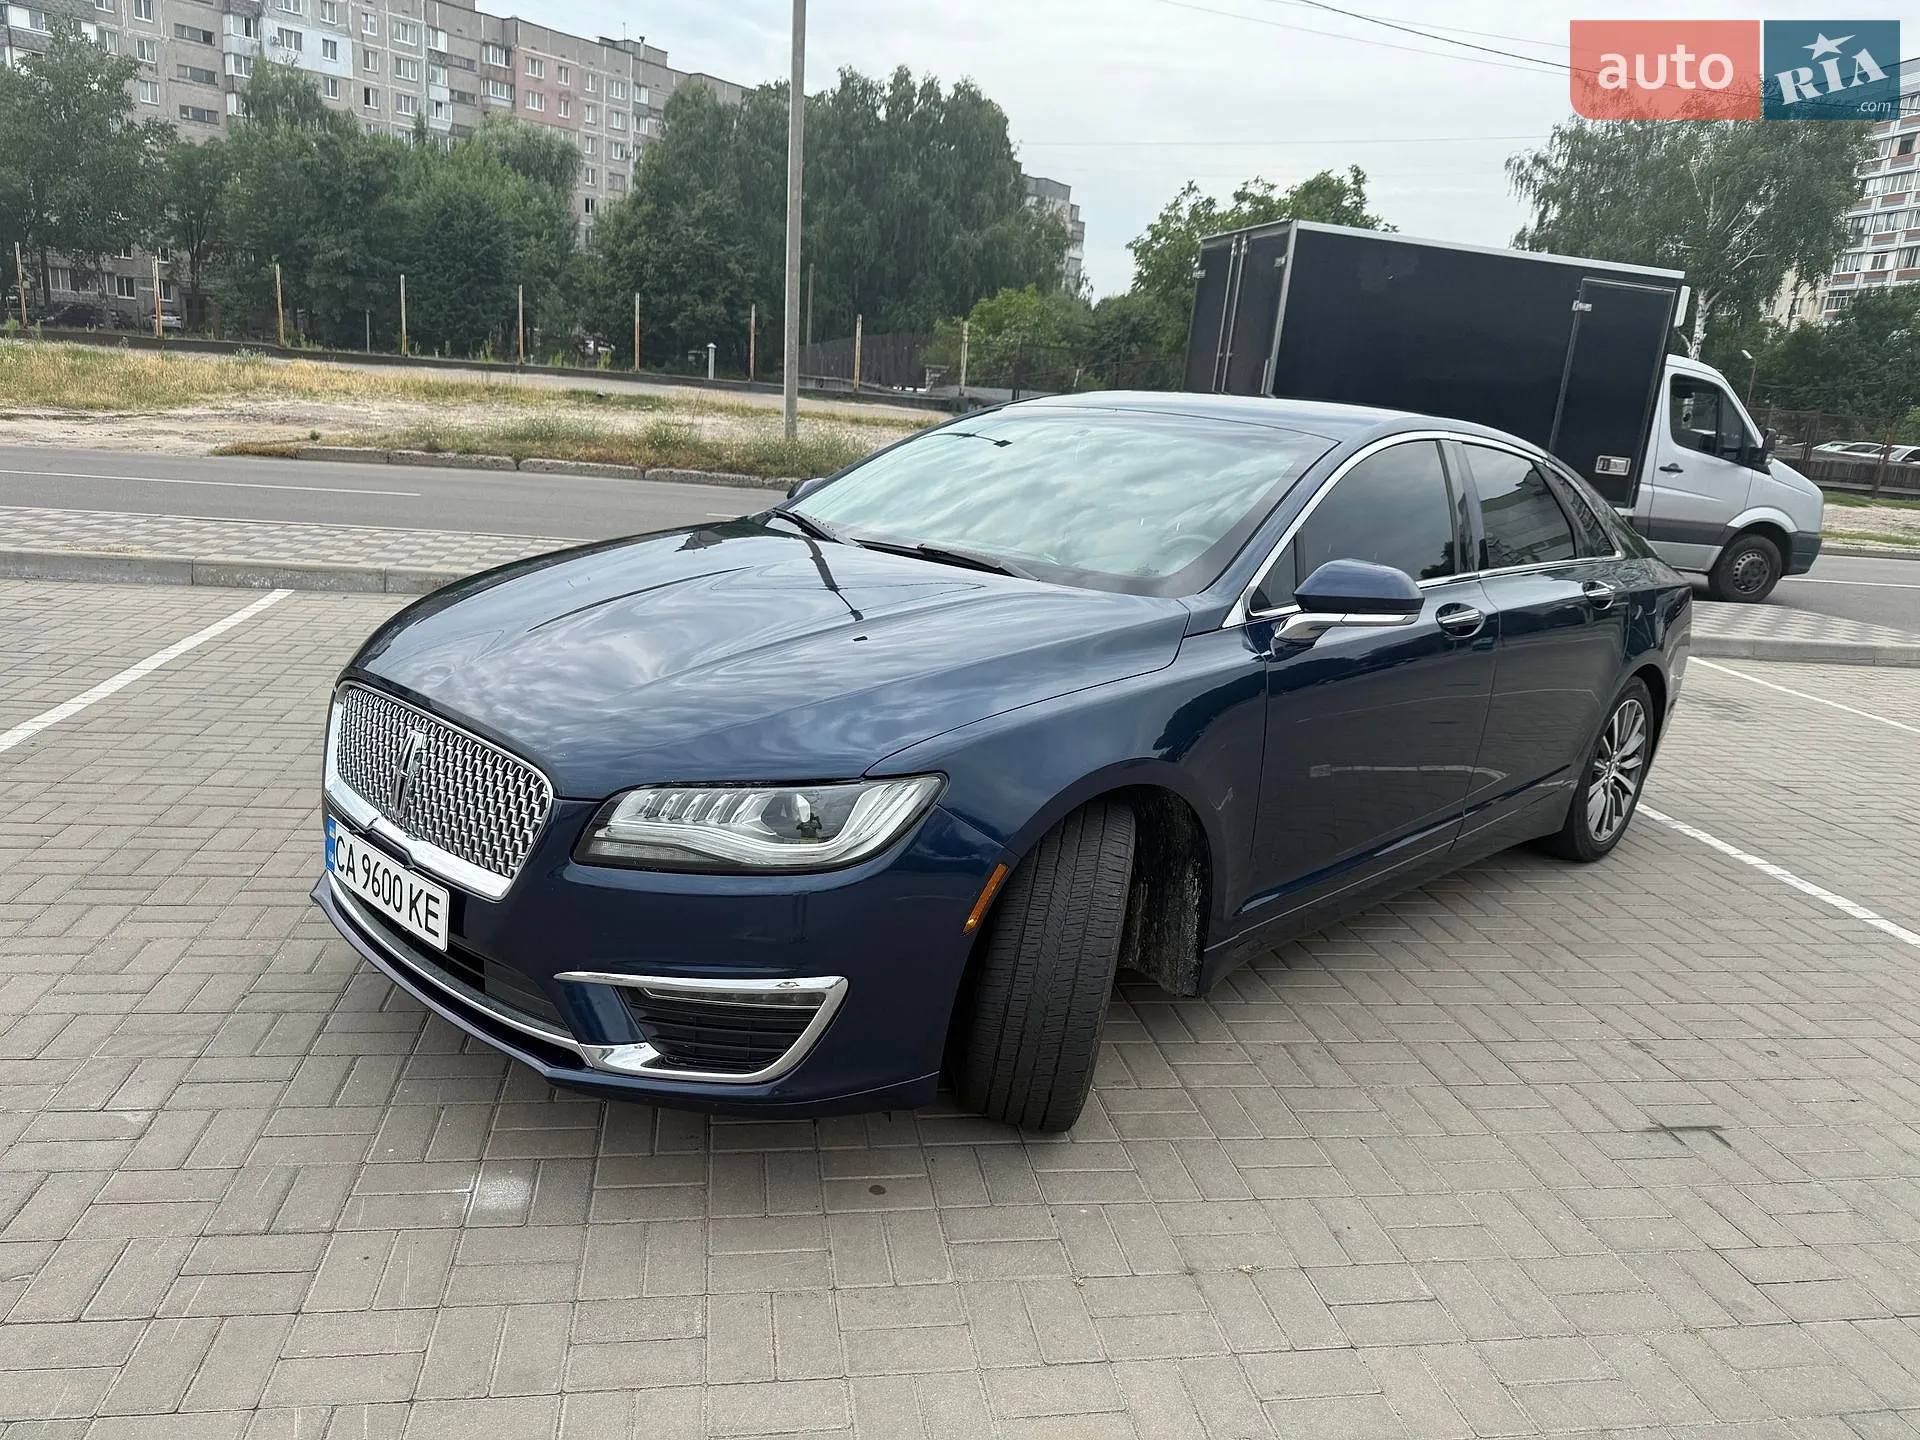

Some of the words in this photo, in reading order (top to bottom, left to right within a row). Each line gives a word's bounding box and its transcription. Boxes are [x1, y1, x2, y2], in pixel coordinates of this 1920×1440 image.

[335, 835, 357, 884] CA
[361, 853, 403, 913] 9600
[408, 882, 440, 938] KE
